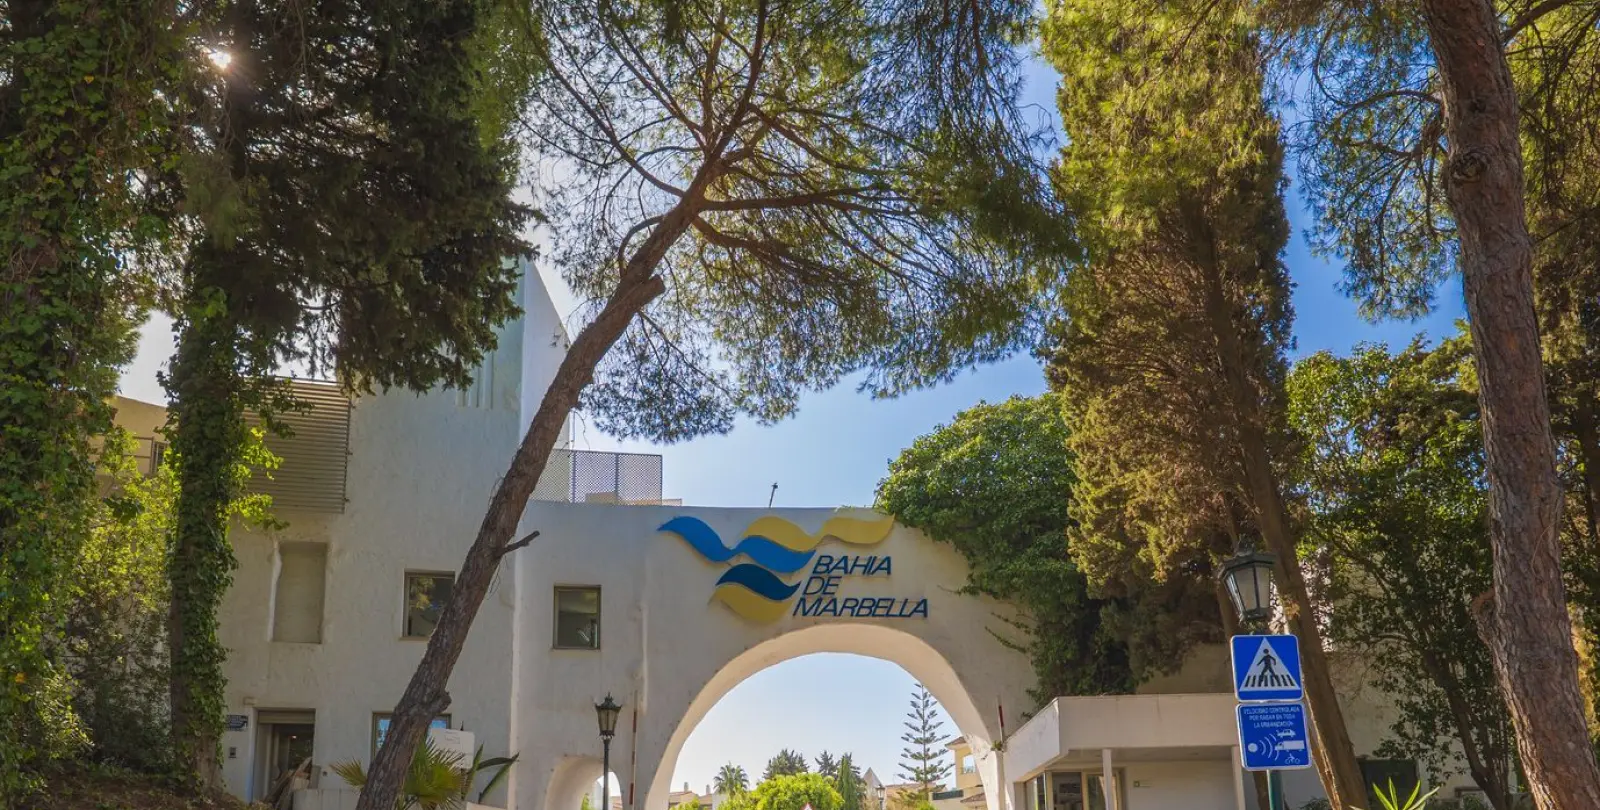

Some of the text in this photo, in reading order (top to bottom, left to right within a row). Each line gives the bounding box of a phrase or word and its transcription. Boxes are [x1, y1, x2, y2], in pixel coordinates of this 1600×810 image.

[813, 555, 892, 576] BAHIA
[803, 576, 842, 595] DE
[792, 597, 928, 618] MARBELLA
